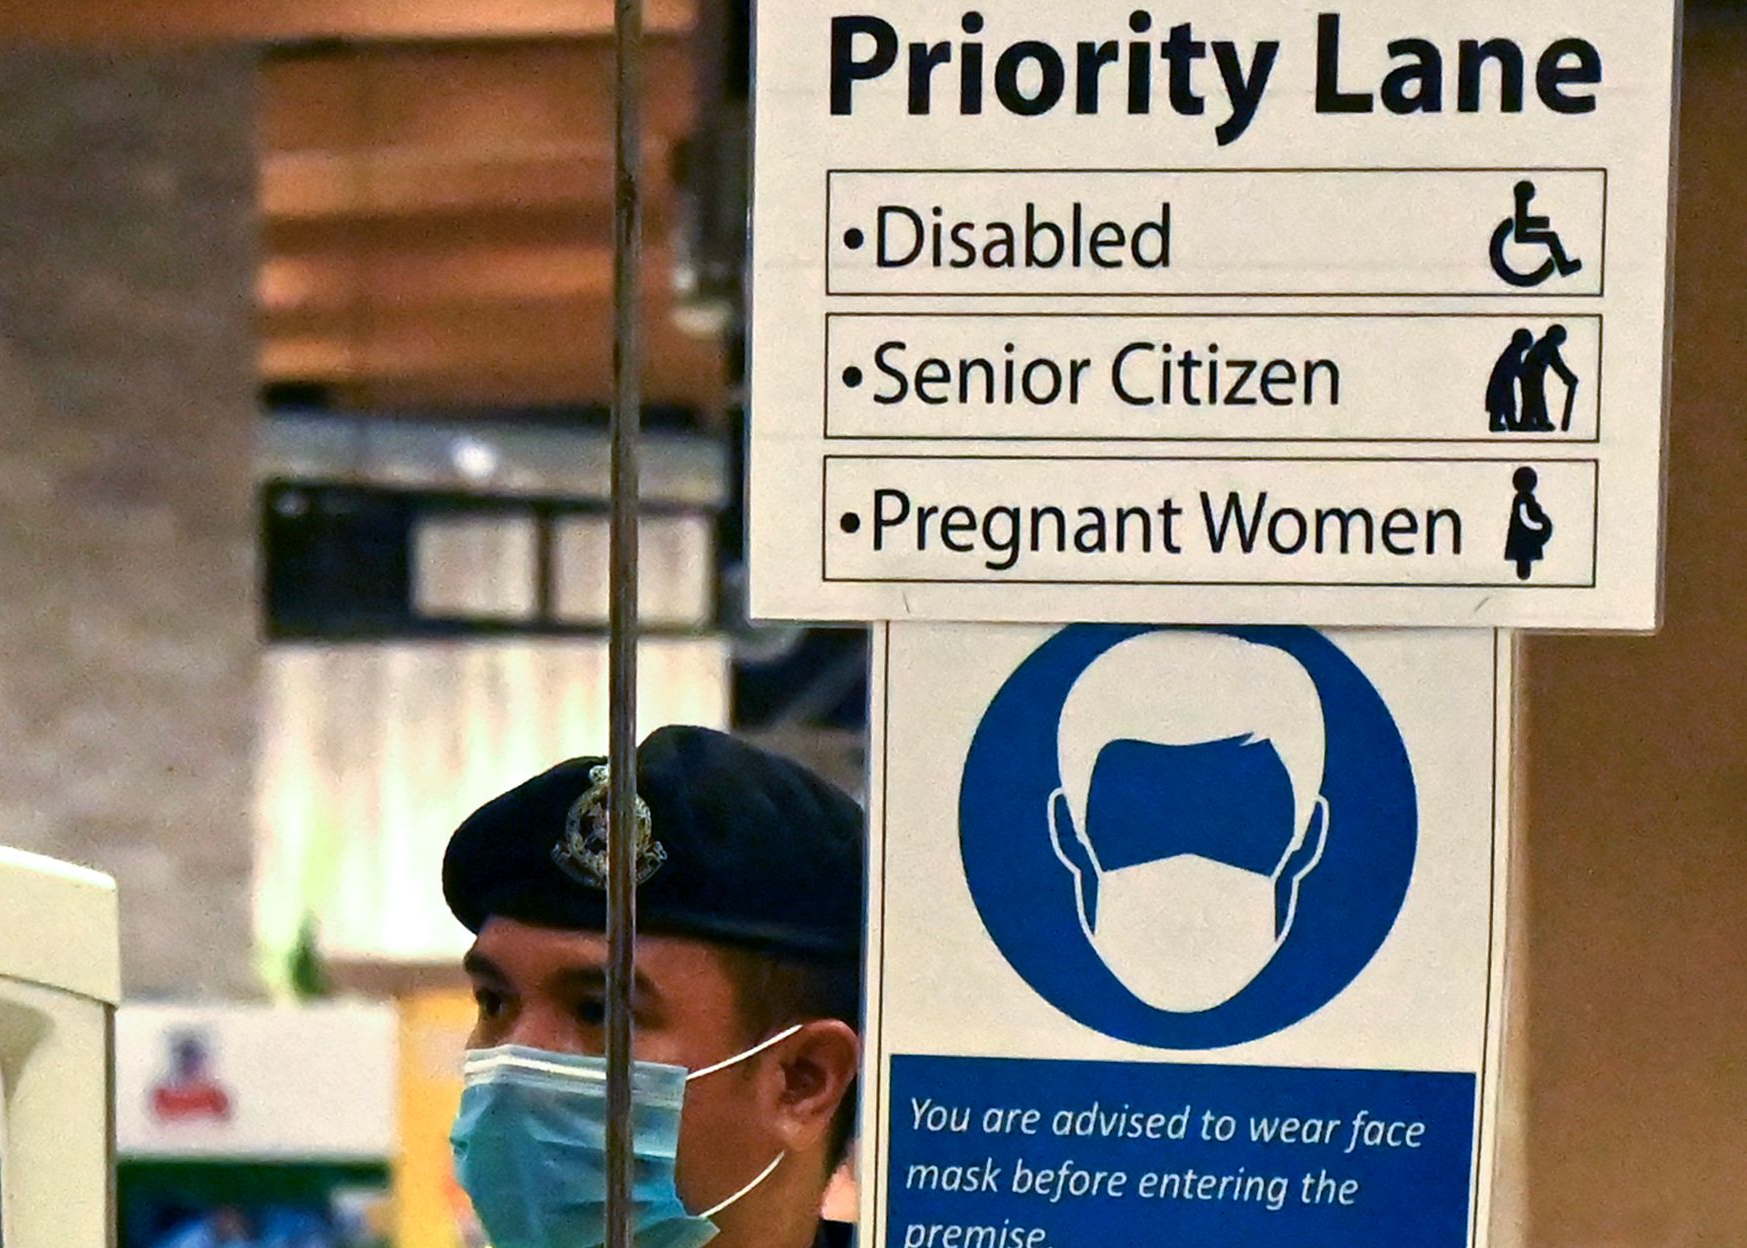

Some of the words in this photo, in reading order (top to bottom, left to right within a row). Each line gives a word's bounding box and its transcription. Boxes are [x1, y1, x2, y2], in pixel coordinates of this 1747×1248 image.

[830, 10, 1279, 146] Priority
[1315, 12, 1602, 115] Lane
[877, 202, 1171, 268] Disabled
[872, 341, 1090, 406] Senior
[1111, 341, 1340, 406] Citizen
[871, 489, 1183, 571] Pregnant
[1200, 491, 1462, 555] Women
[911, 1097, 971, 1132] You
[982, 1107, 1041, 1135] are
[1052, 1101, 1191, 1140] advised
[1201, 1109, 1236, 1142] to
[1250, 1116, 1340, 1145] wear
[1344, 1110, 1426, 1154] face
[906, 1156, 1001, 1192] mask
[1011, 1158, 1128, 1203] before
[1138, 1166, 1289, 1211] entering
[1301, 1169, 1359, 1205] the
